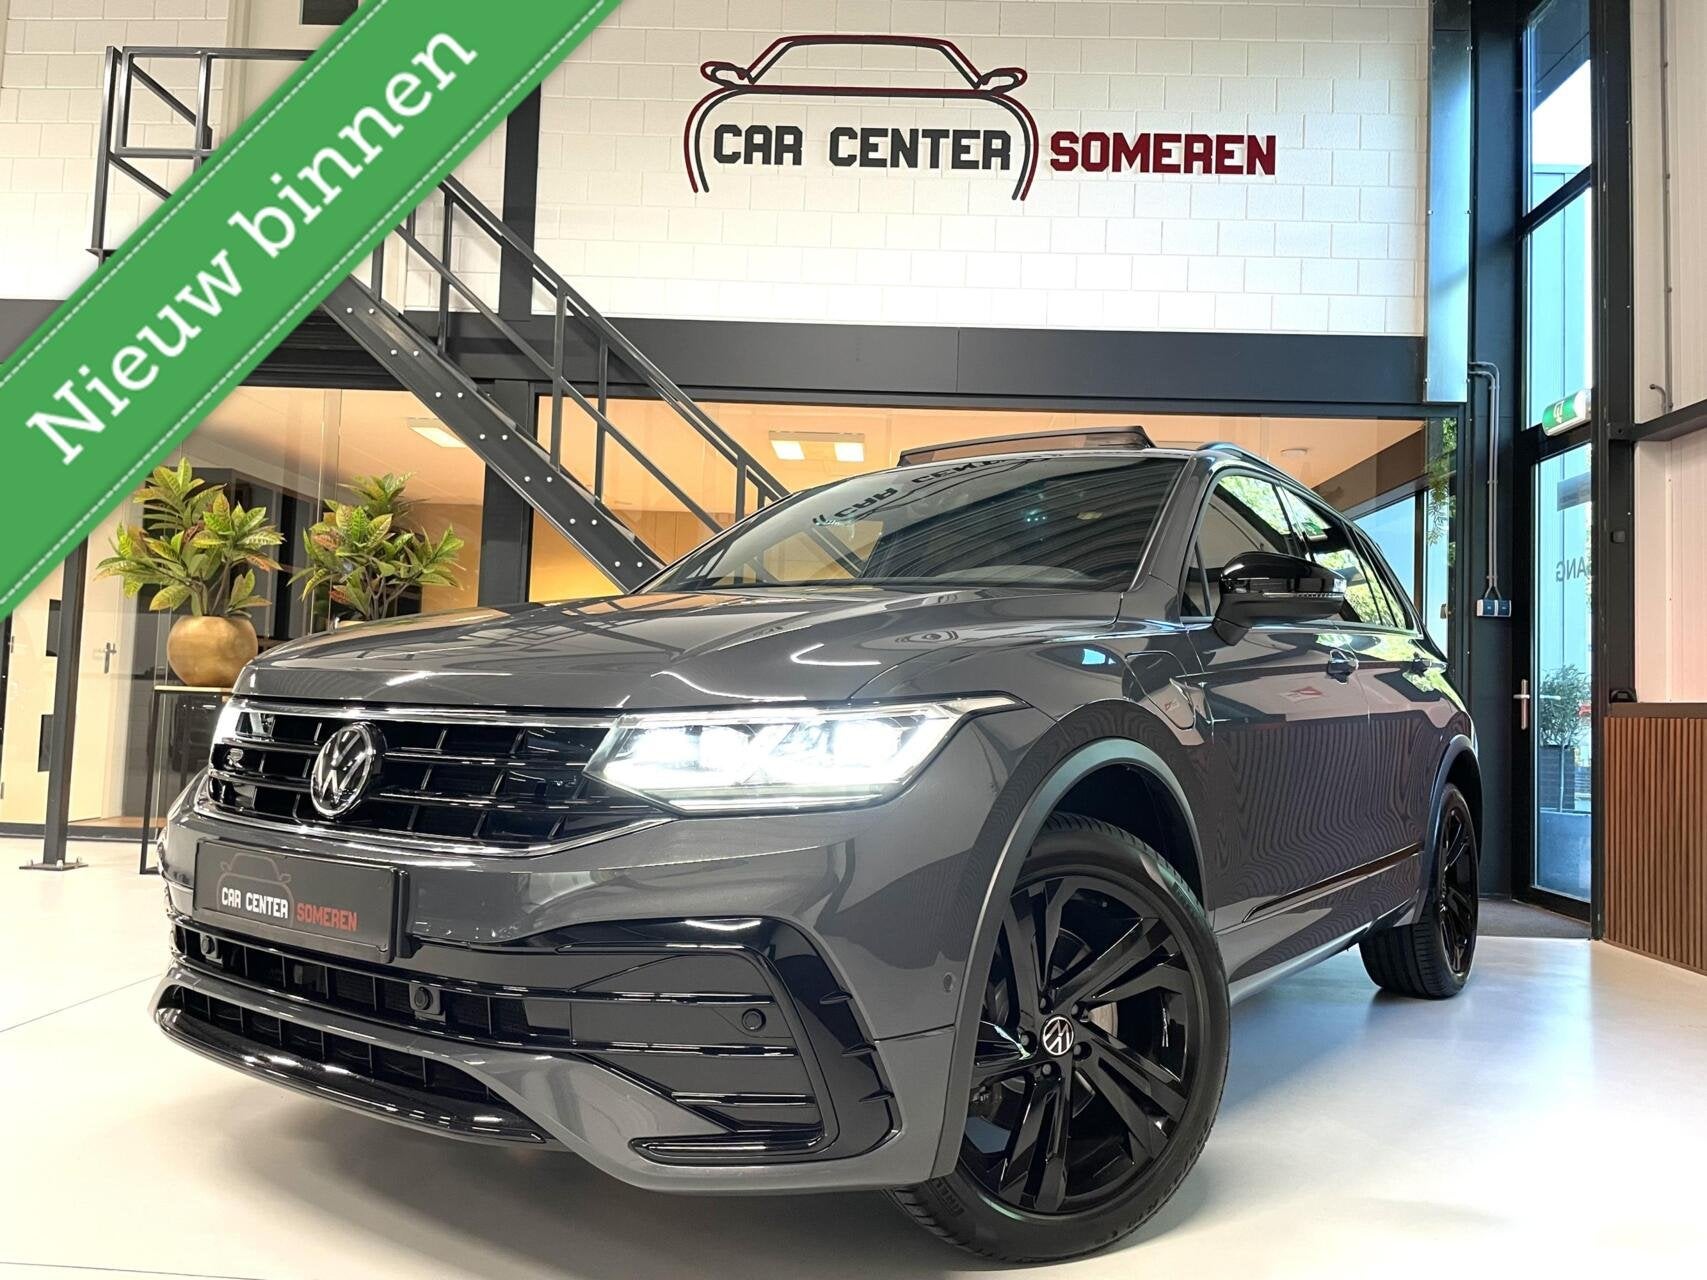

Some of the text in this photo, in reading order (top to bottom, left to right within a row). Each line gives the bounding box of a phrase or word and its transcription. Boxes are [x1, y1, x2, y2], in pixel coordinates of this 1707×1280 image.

[713, 123, 1277, 176] CAR CENTER SOMEREN
[221, 887, 358, 932] CAR CENTER SOMEREN
